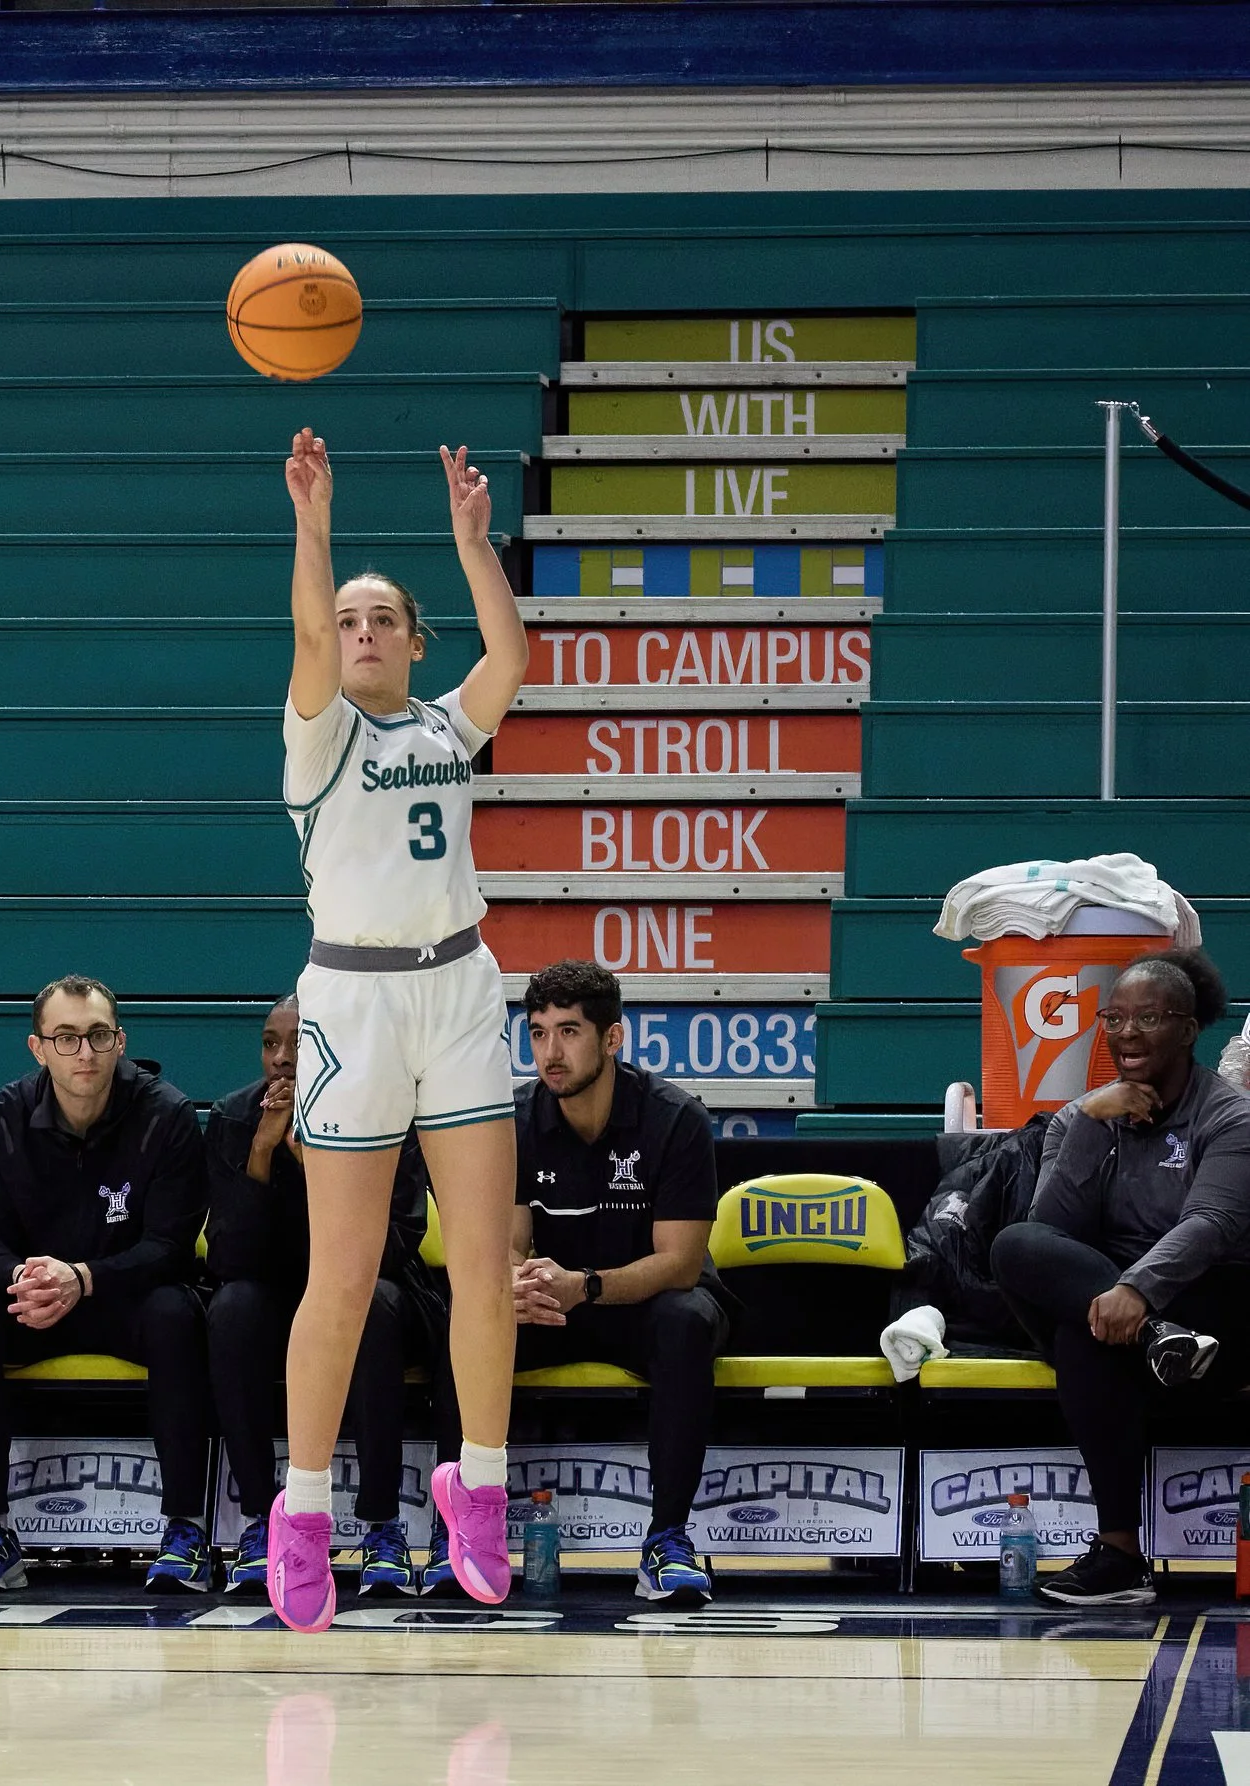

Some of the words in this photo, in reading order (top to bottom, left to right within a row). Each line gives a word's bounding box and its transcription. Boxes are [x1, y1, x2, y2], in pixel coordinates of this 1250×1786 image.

[730, 320, 796, 363] US
[680, 392, 816, 436] WITH
[685, 469, 790, 515] LIVE
[540, 632, 611, 686] TO
[637, 630, 871, 686] CAMPUS
[361, 749, 471, 793] Seahawks
[586, 719, 797, 775] STROLL
[408, 801, 447, 861] 3
[581, 809, 771, 872] BLOCK
[593, 906, 714, 970] ONE
[1024, 975, 1080, 1040] G
[740, 1194, 868, 1239] UNCW
[7, 1452, 164, 1502] CAPITA
[507, 1458, 653, 1508] APITAL
[692, 1461, 891, 1515] CAPITAL
[45, 1499, 77, 1513] Ford
[738, 1509, 770, 1522] Ford
[707, 1526, 873, 1544] WILMINGTON
